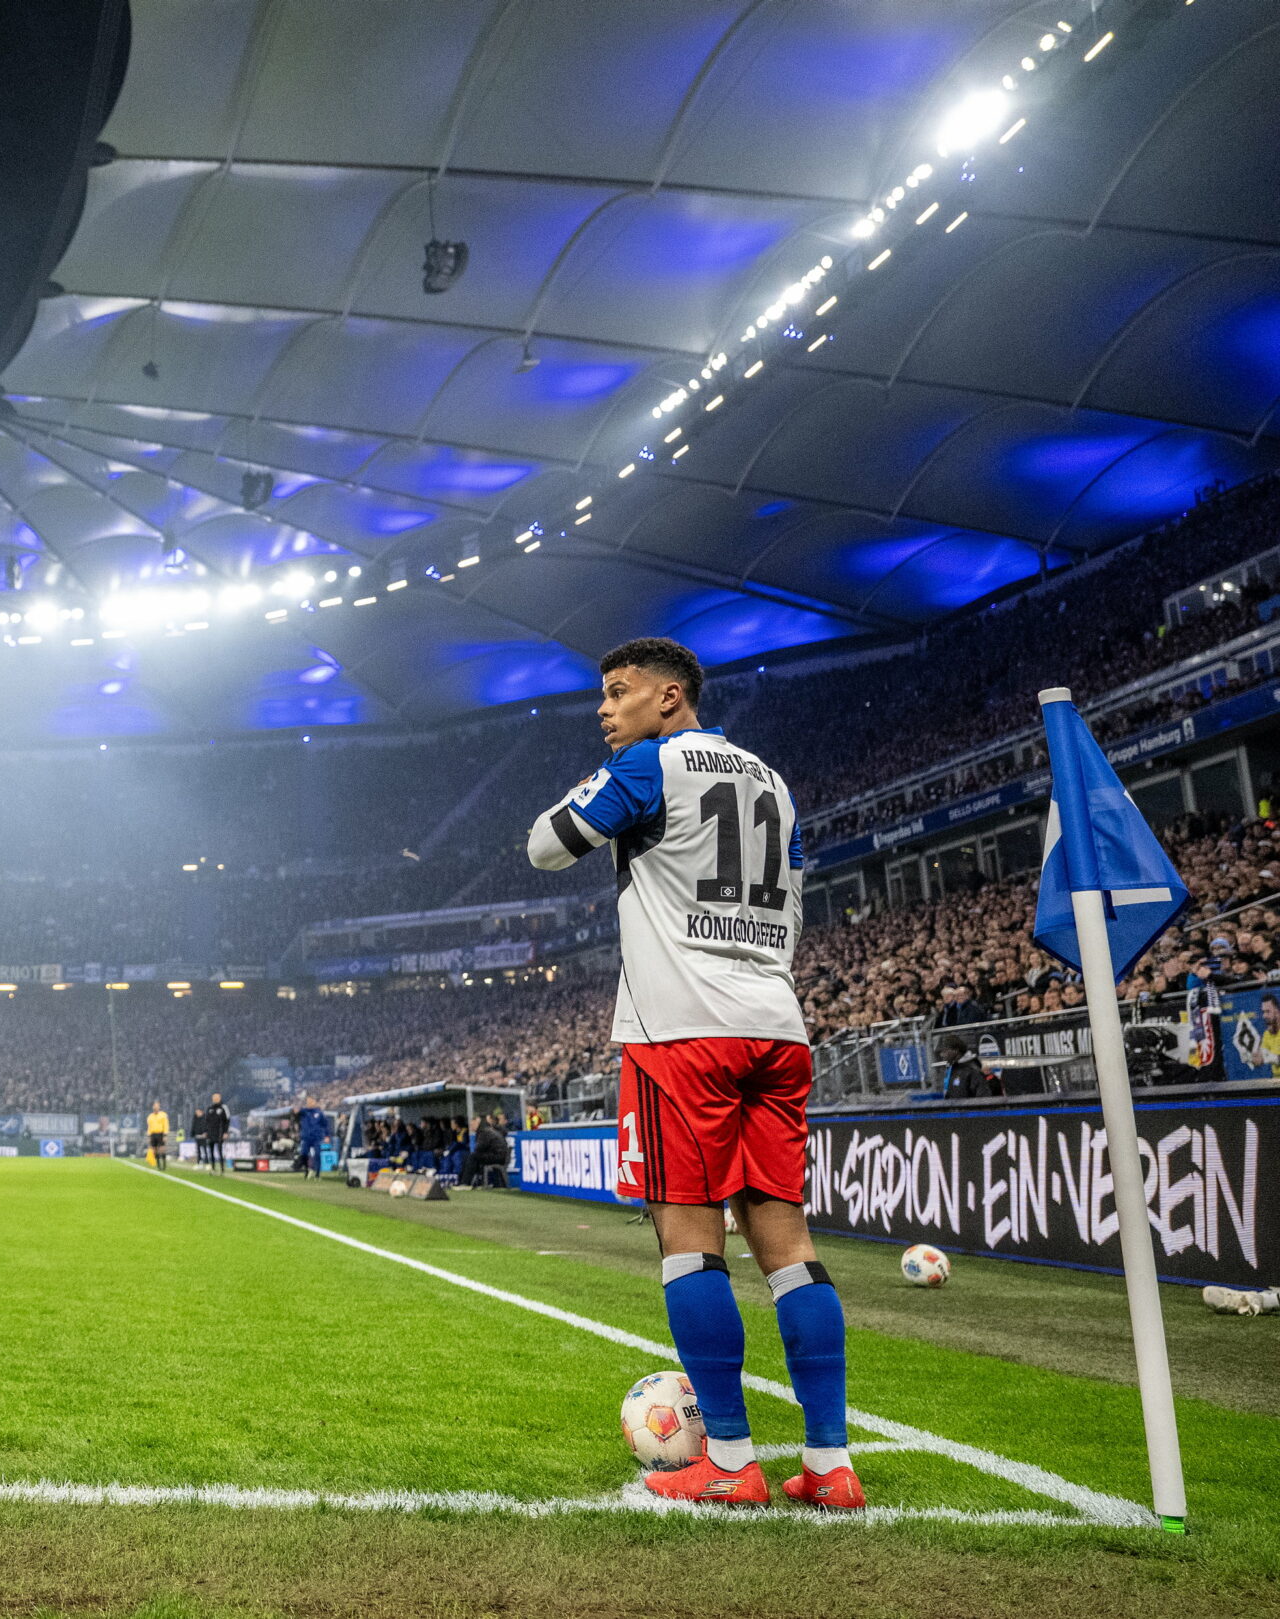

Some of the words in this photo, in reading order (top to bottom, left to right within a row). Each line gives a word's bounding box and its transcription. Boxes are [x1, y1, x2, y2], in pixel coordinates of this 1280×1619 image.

[1107, 742, 1139, 765] Gruppe
[1139, 728, 1181, 754] Hamburg
[696, 781, 788, 912] 11
[521, 1138, 603, 1190] HSV-FRAUEN
